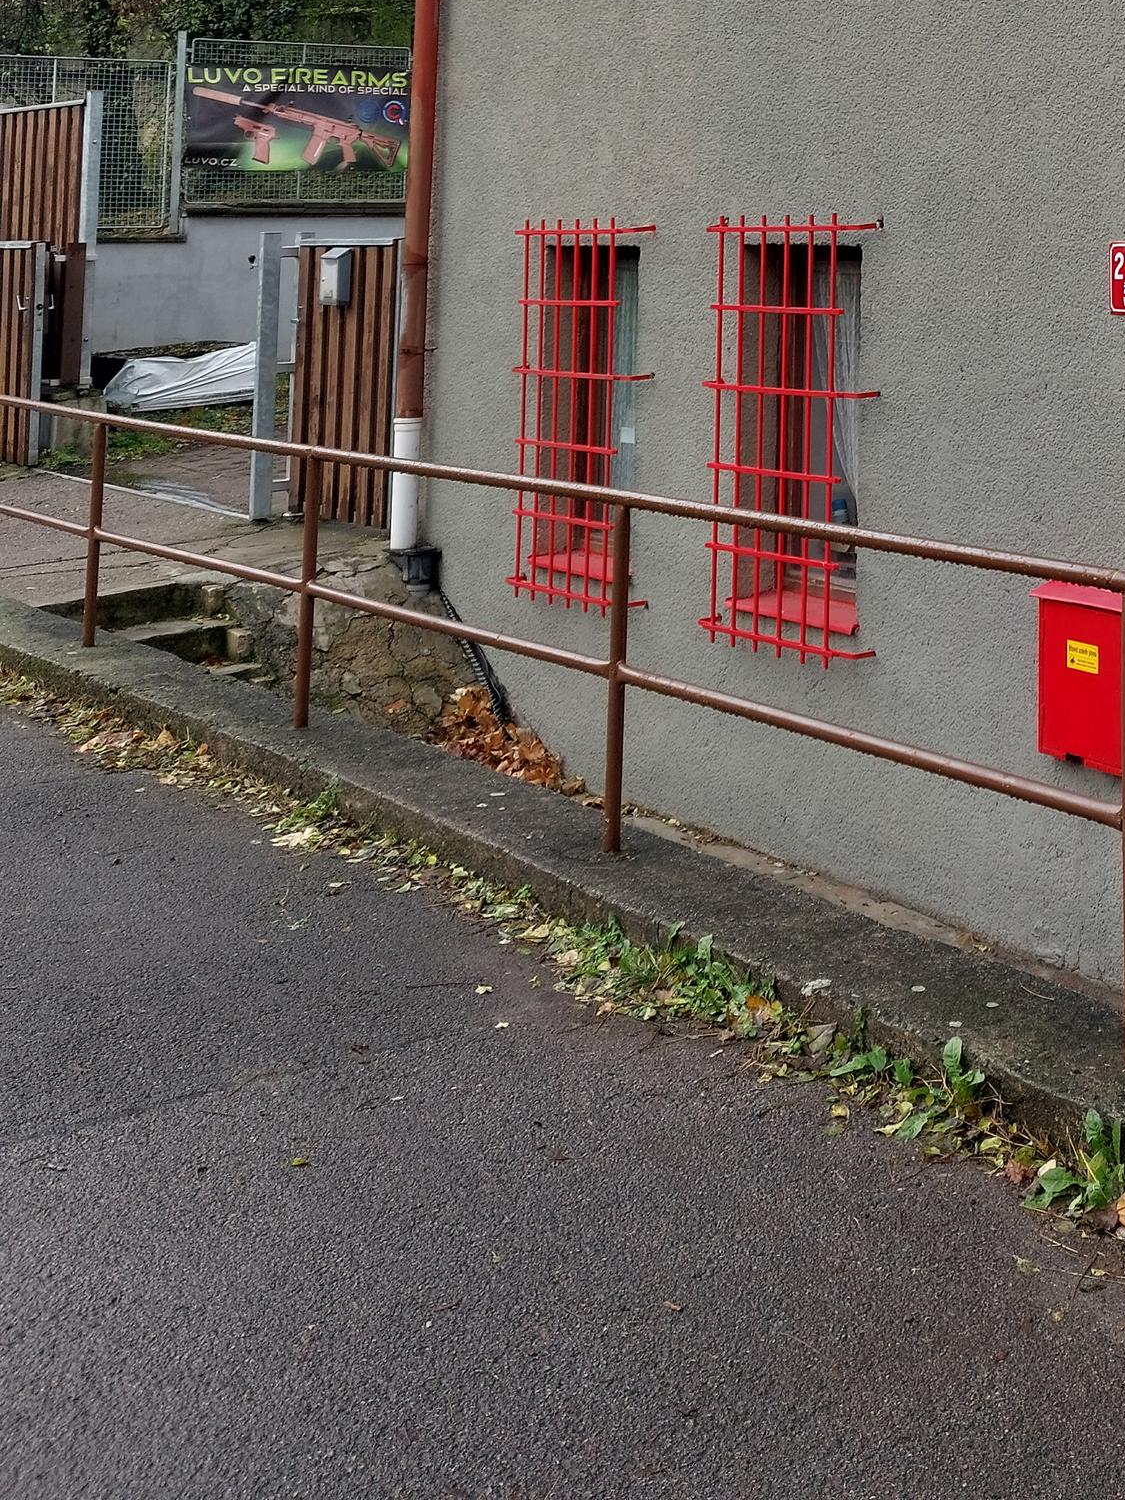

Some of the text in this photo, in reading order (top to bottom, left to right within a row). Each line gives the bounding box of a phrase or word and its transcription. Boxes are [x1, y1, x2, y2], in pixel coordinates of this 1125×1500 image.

[187, 67, 408, 88] LUVO FIREARMS
[242, 83, 408, 96] A SPECIAL KIND OF SPECIAL
[184, 156, 238, 167] LUVO.CZ
